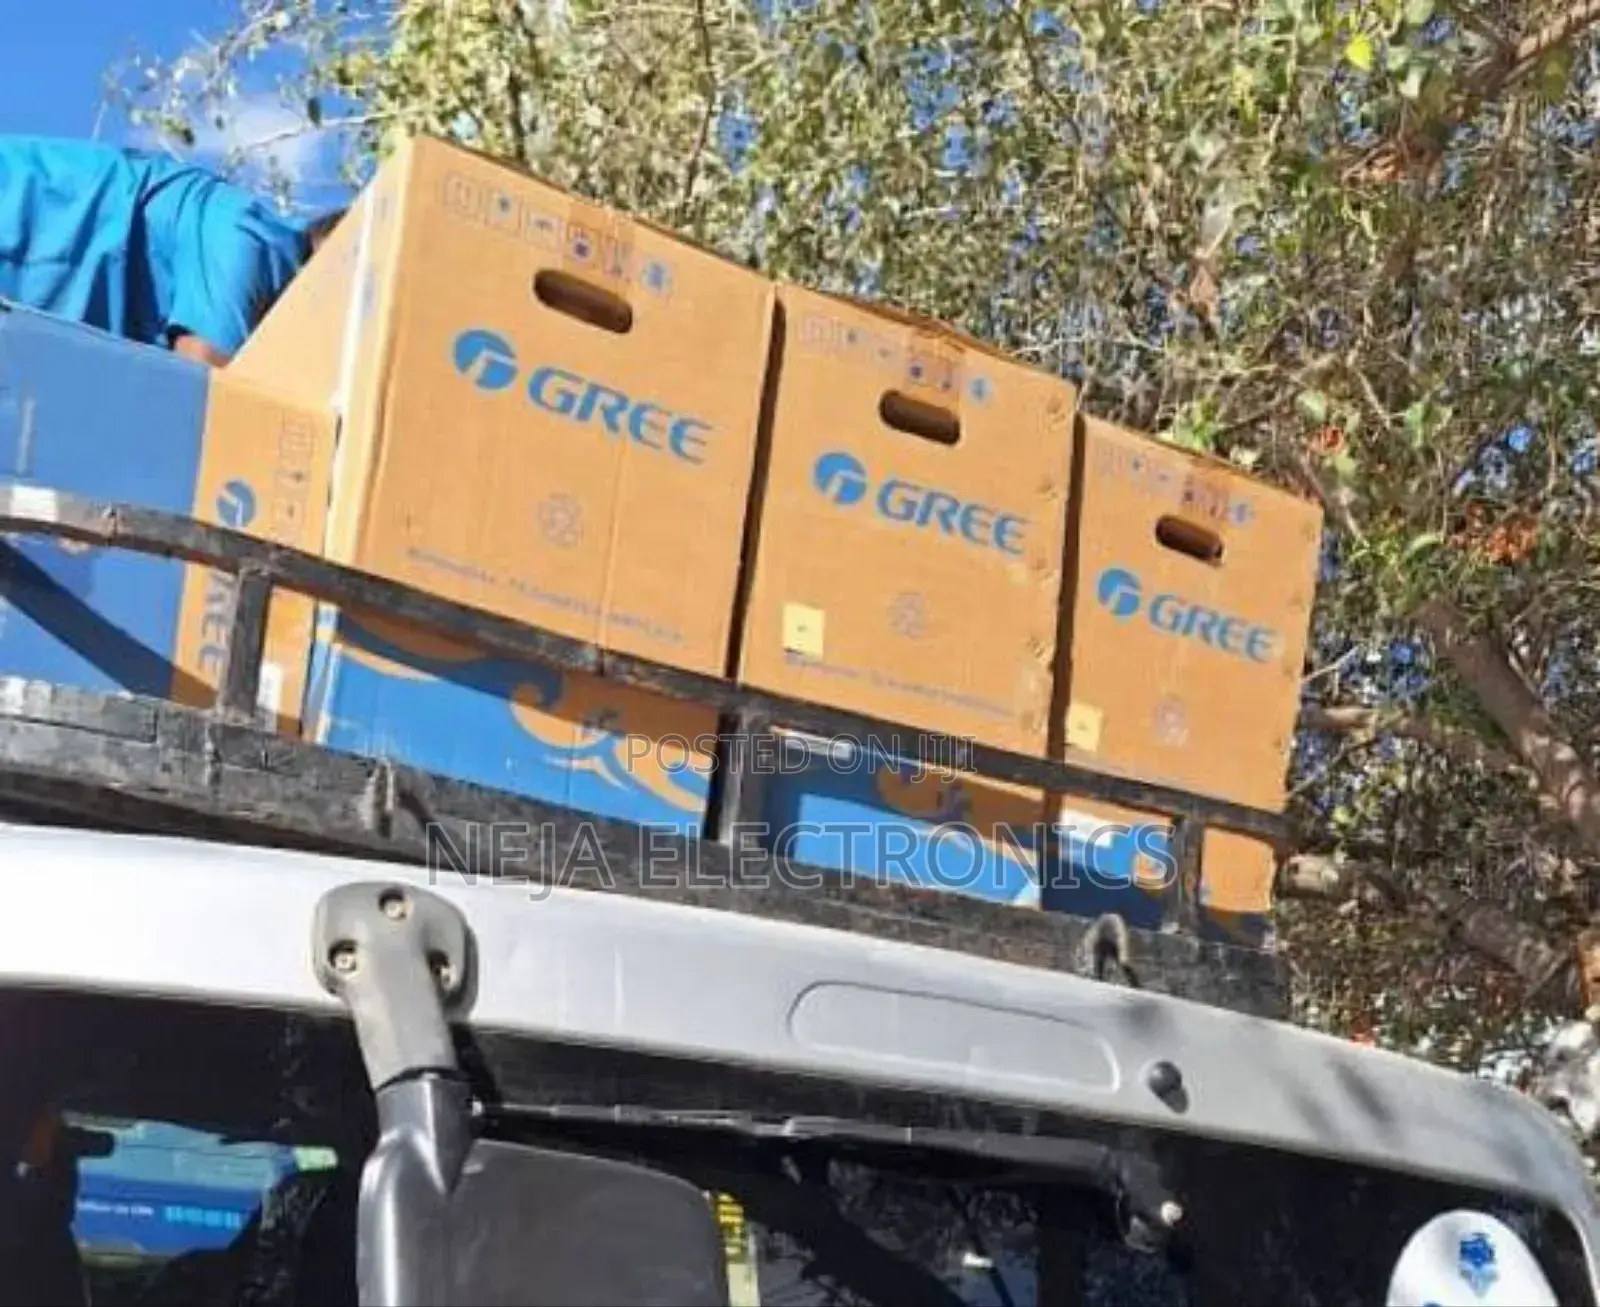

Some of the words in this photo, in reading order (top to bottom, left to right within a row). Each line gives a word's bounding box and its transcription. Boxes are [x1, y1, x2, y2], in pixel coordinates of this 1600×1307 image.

[528, 370, 714, 465] GREE
[877, 478, 1028, 557] GREE
[1148, 593, 1276, 664] GREE
